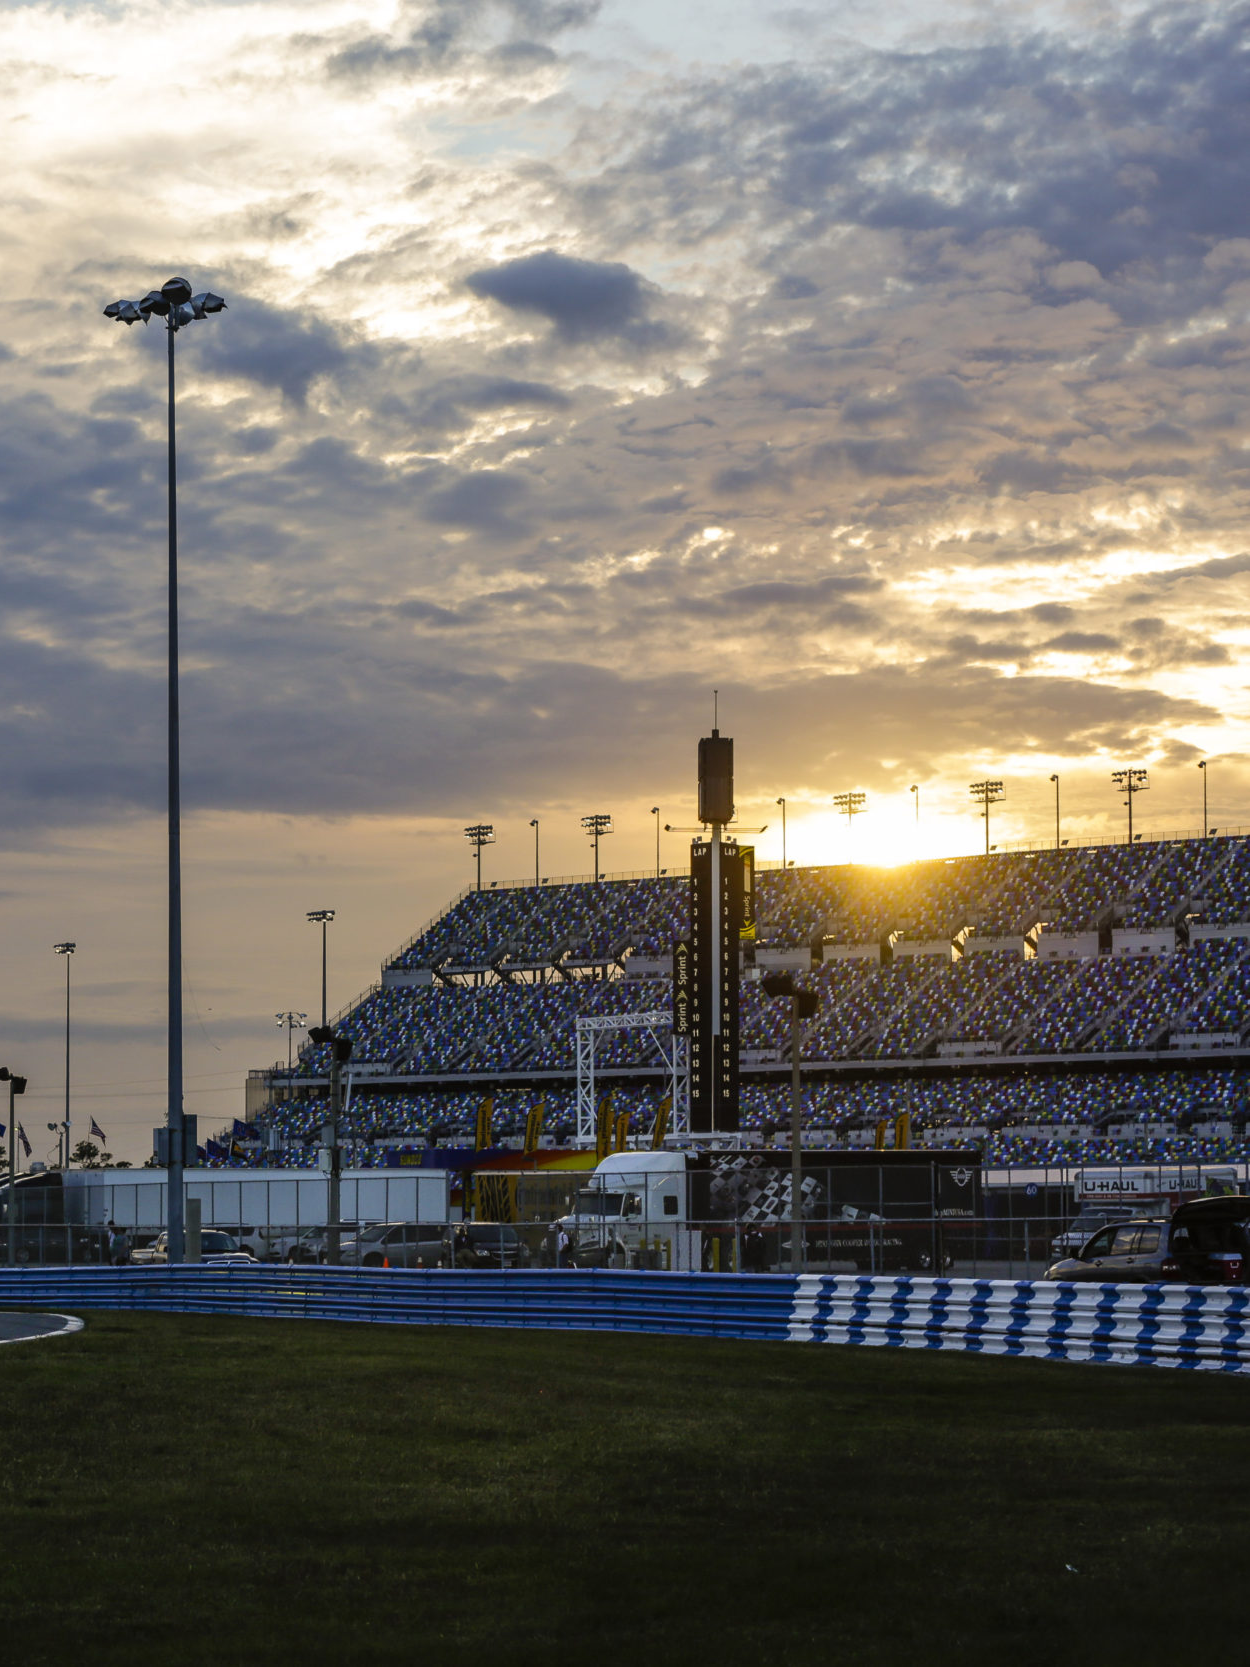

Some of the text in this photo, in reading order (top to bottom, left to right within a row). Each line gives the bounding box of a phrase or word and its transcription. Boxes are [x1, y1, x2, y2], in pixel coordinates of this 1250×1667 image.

[693, 848, 707, 857] LAP
[724, 848, 736, 857] LAP
[693, 878, 698, 887] 1
[724, 877, 729, 886] 1
[693, 893, 698, 902] 2
[724, 892, 729, 901] 2
[743, 896, 751, 917] Sprint
[693, 908, 698, 917] 3
[724, 907, 729, 916] 3
[693, 923, 698, 932] 4
[724, 922, 729, 931] 4
[693, 953, 698, 962] 6
[724, 952, 729, 961] 6
[678, 955, 689, 985] Sprint
[693, 968, 698, 977] 7
[724, 967, 729, 976] 7
[678, 1002, 689, 1032] Sprint
[692, 1013, 699, 1022] 10
[723, 1013, 730, 1022] 10
[692, 1028, 699, 1037] 11
[723, 1028, 730, 1037] 11
[692, 1043, 699, 1052] 12
[723, 1043, 730, 1052] 12
[692, 1058, 699, 1067] 13
[723, 1058, 730, 1067] 13
[692, 1074, 699, 1083] 14
[723, 1073, 730, 1082] 14
[692, 1089, 699, 1098] 15
[723, 1089, 730, 1098] 15
[1084, 1181, 1138, 1191] U-HAUL
[1169, 1178, 1202, 1190] U-HAU
[1026, 1184, 1037, 1194] 60
